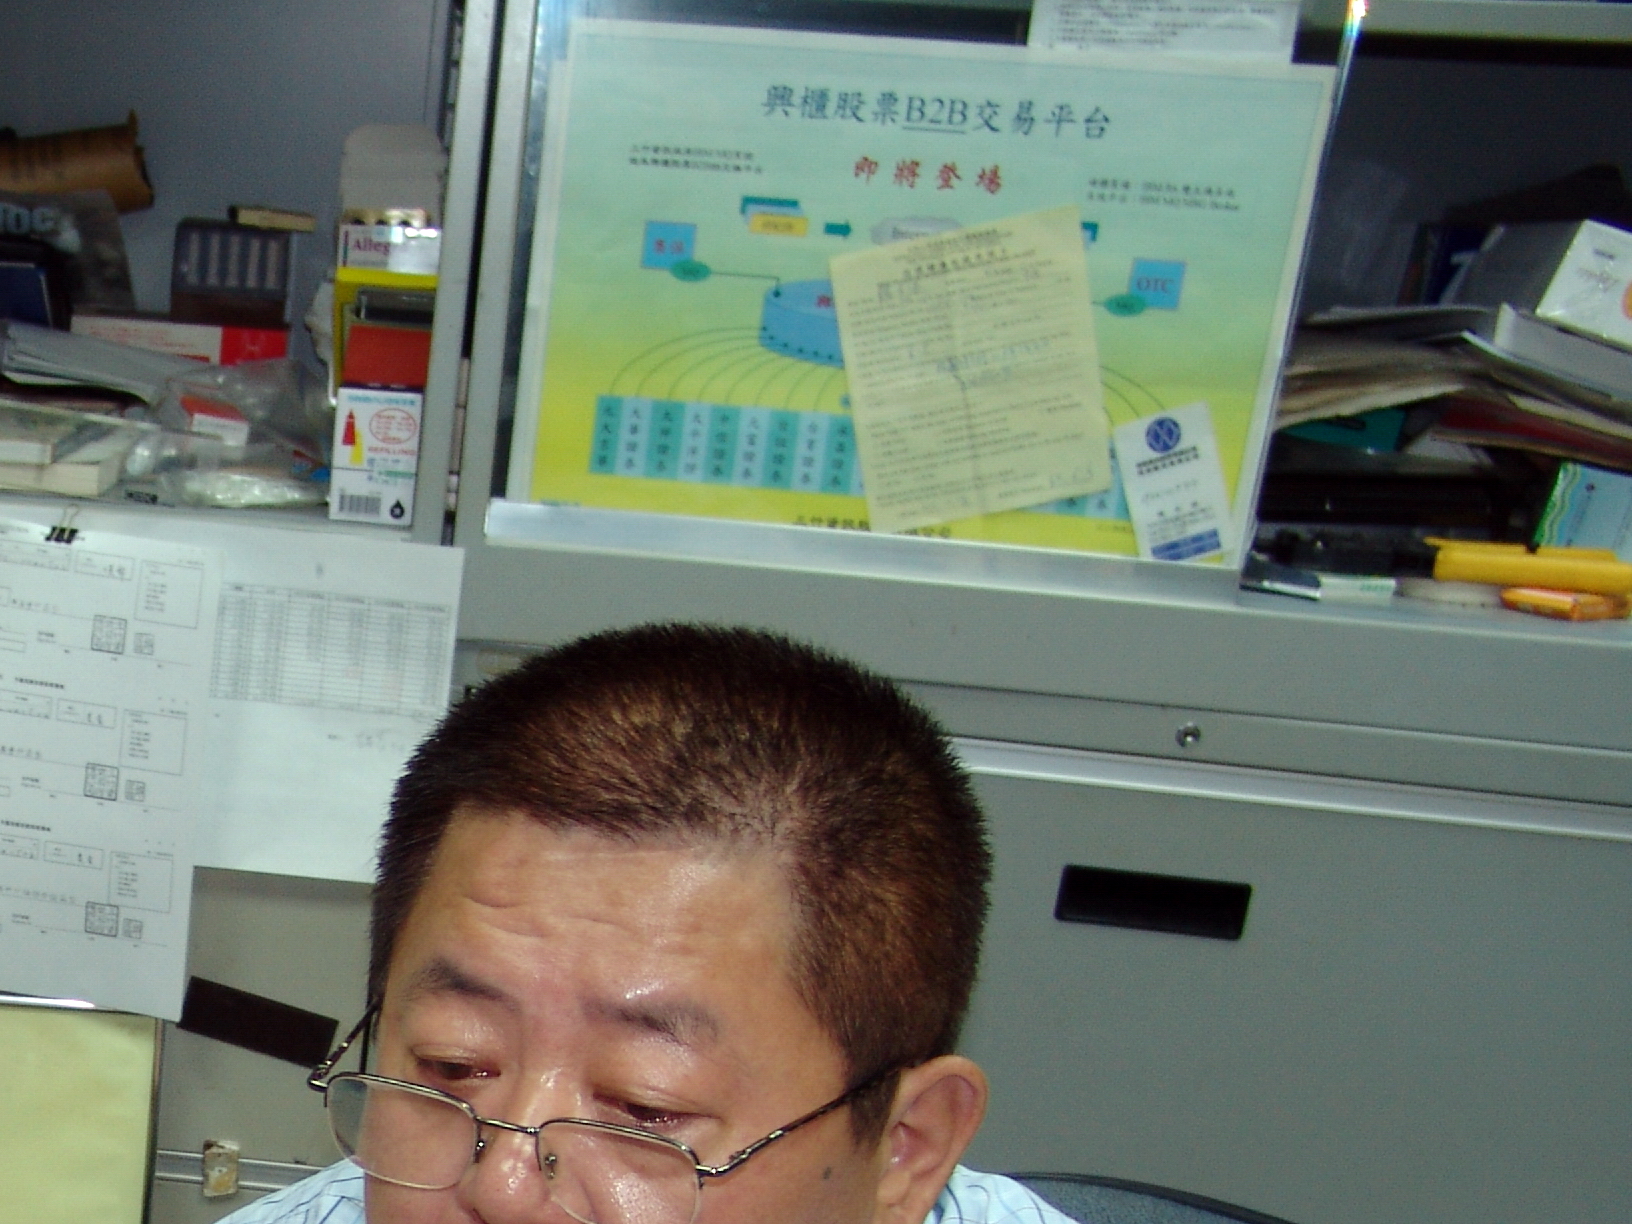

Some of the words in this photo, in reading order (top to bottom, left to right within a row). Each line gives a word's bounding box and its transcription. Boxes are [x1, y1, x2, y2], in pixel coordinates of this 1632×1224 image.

[761, 84, 1111, 140] 興櫃股票B2B交易平台
[854, 156, 1003, 195] 即將登場
[1135, 276, 1174, 295] OTC
